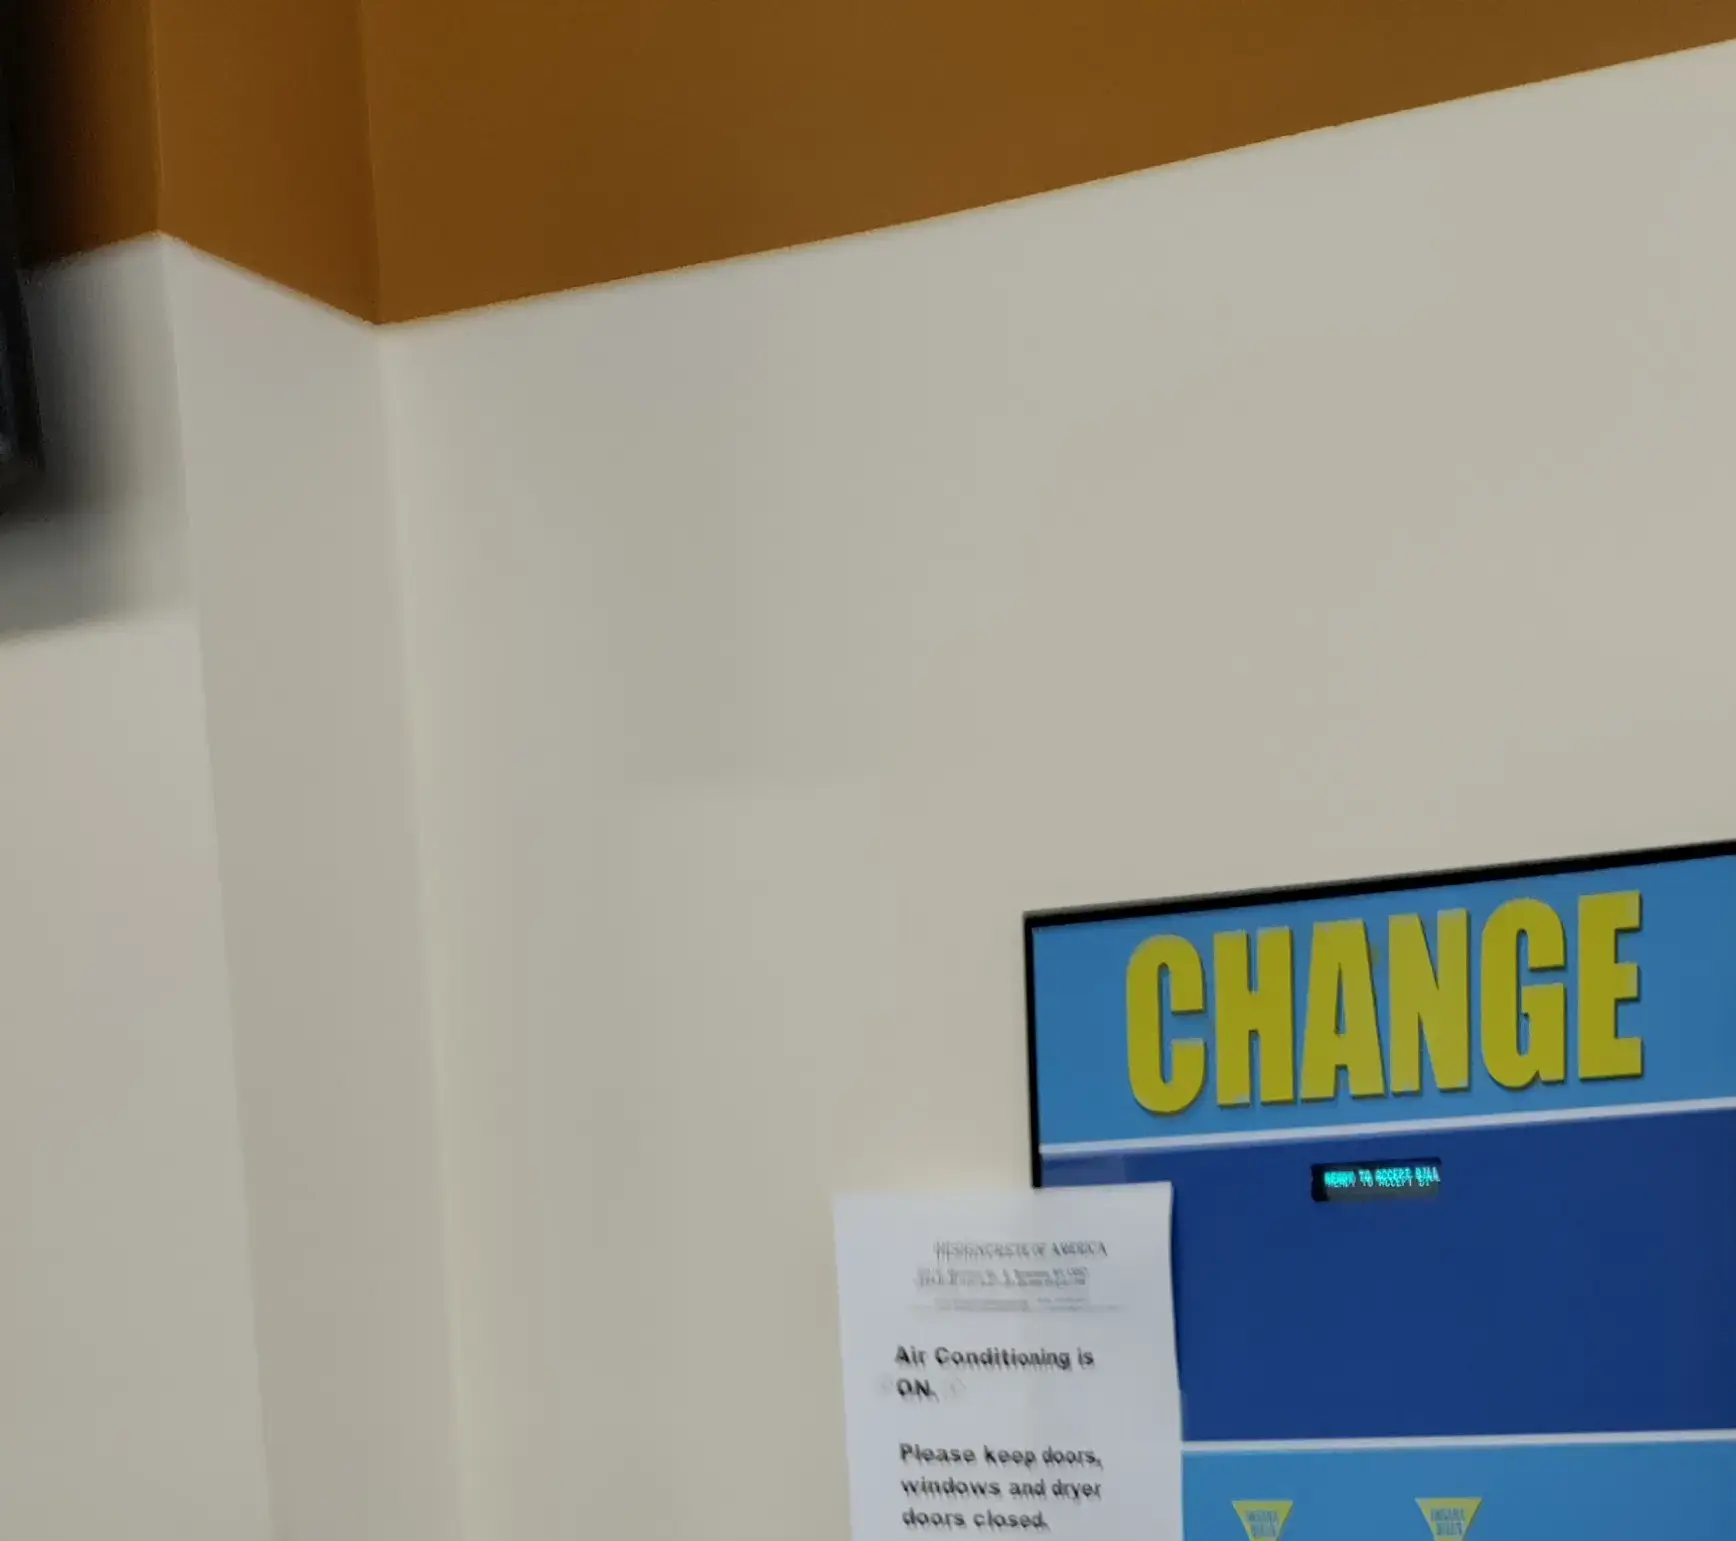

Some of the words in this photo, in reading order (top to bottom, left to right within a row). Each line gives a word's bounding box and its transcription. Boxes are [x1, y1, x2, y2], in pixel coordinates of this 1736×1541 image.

[1126, 891, 1643, 1113] CHANGE
[1359, 1168, 1373, 1186] TO
[1375, 1167, 1412, 1185] ACCEPT
[896, 1346, 926, 1366] Air
[935, 1347, 1071, 1370] Conditioning
[1078, 1348, 1094, 1367] is
[900, 1443, 976, 1465] Please
[983, 1445, 1036, 1470] keep
[902, 1476, 1001, 1498] windows
[1009, 1479, 1046, 1498] and
[1052, 1479, 1101, 1503] dryer
[902, 1508, 966, 1528] doors
